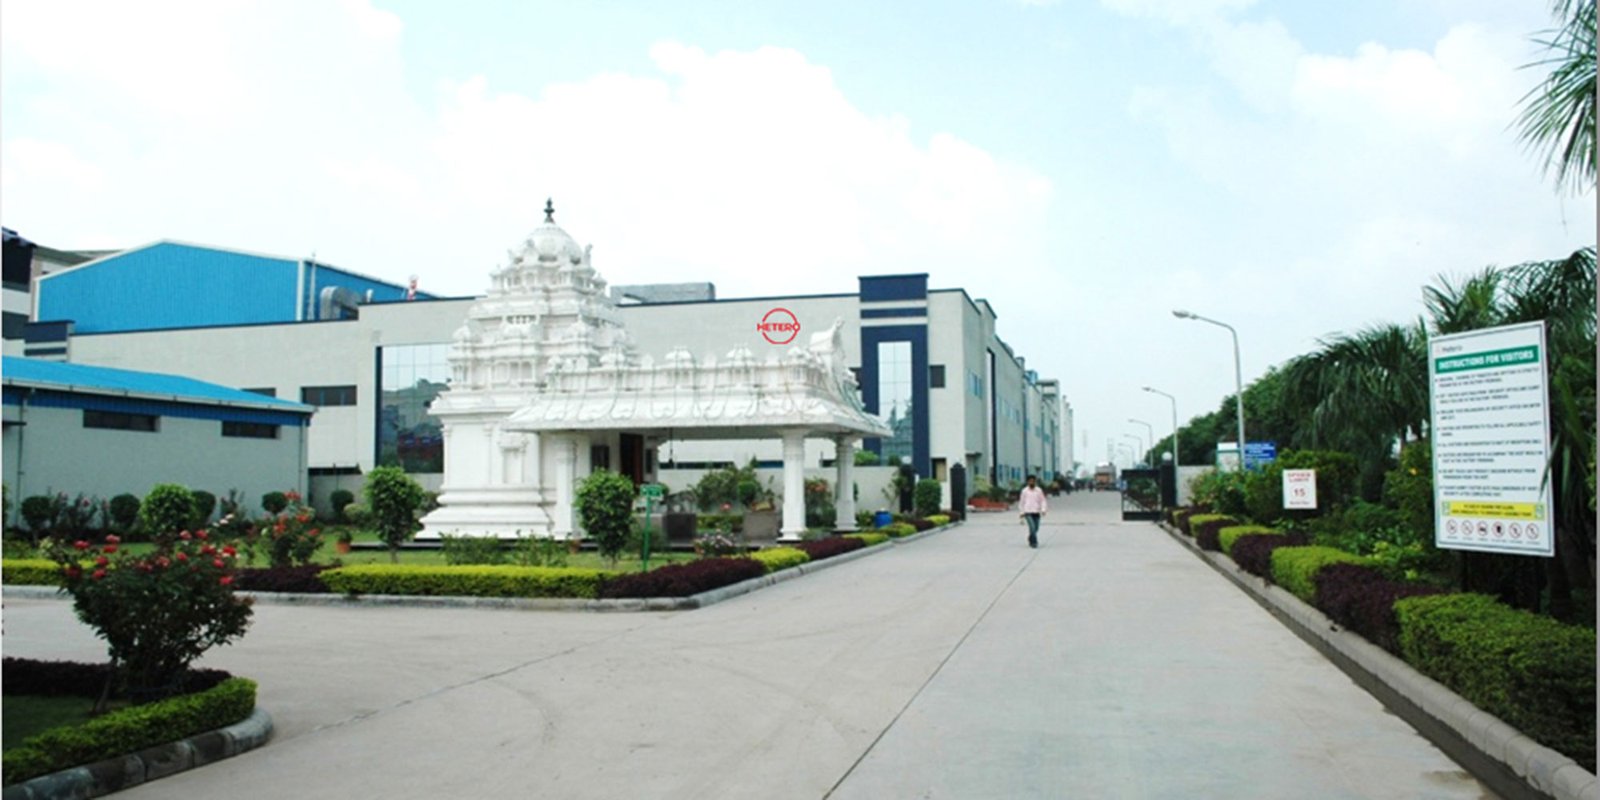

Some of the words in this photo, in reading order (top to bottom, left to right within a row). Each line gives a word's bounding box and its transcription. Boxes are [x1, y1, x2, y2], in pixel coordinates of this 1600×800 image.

[757, 322, 800, 332] HETERO
[1438, 356, 1484, 370] INSTRUCTIONS
[1485, 353, 1499, 364] FOR
[1500, 350, 1534, 363] VISITORS
[1294, 488, 1306, 497] 15
